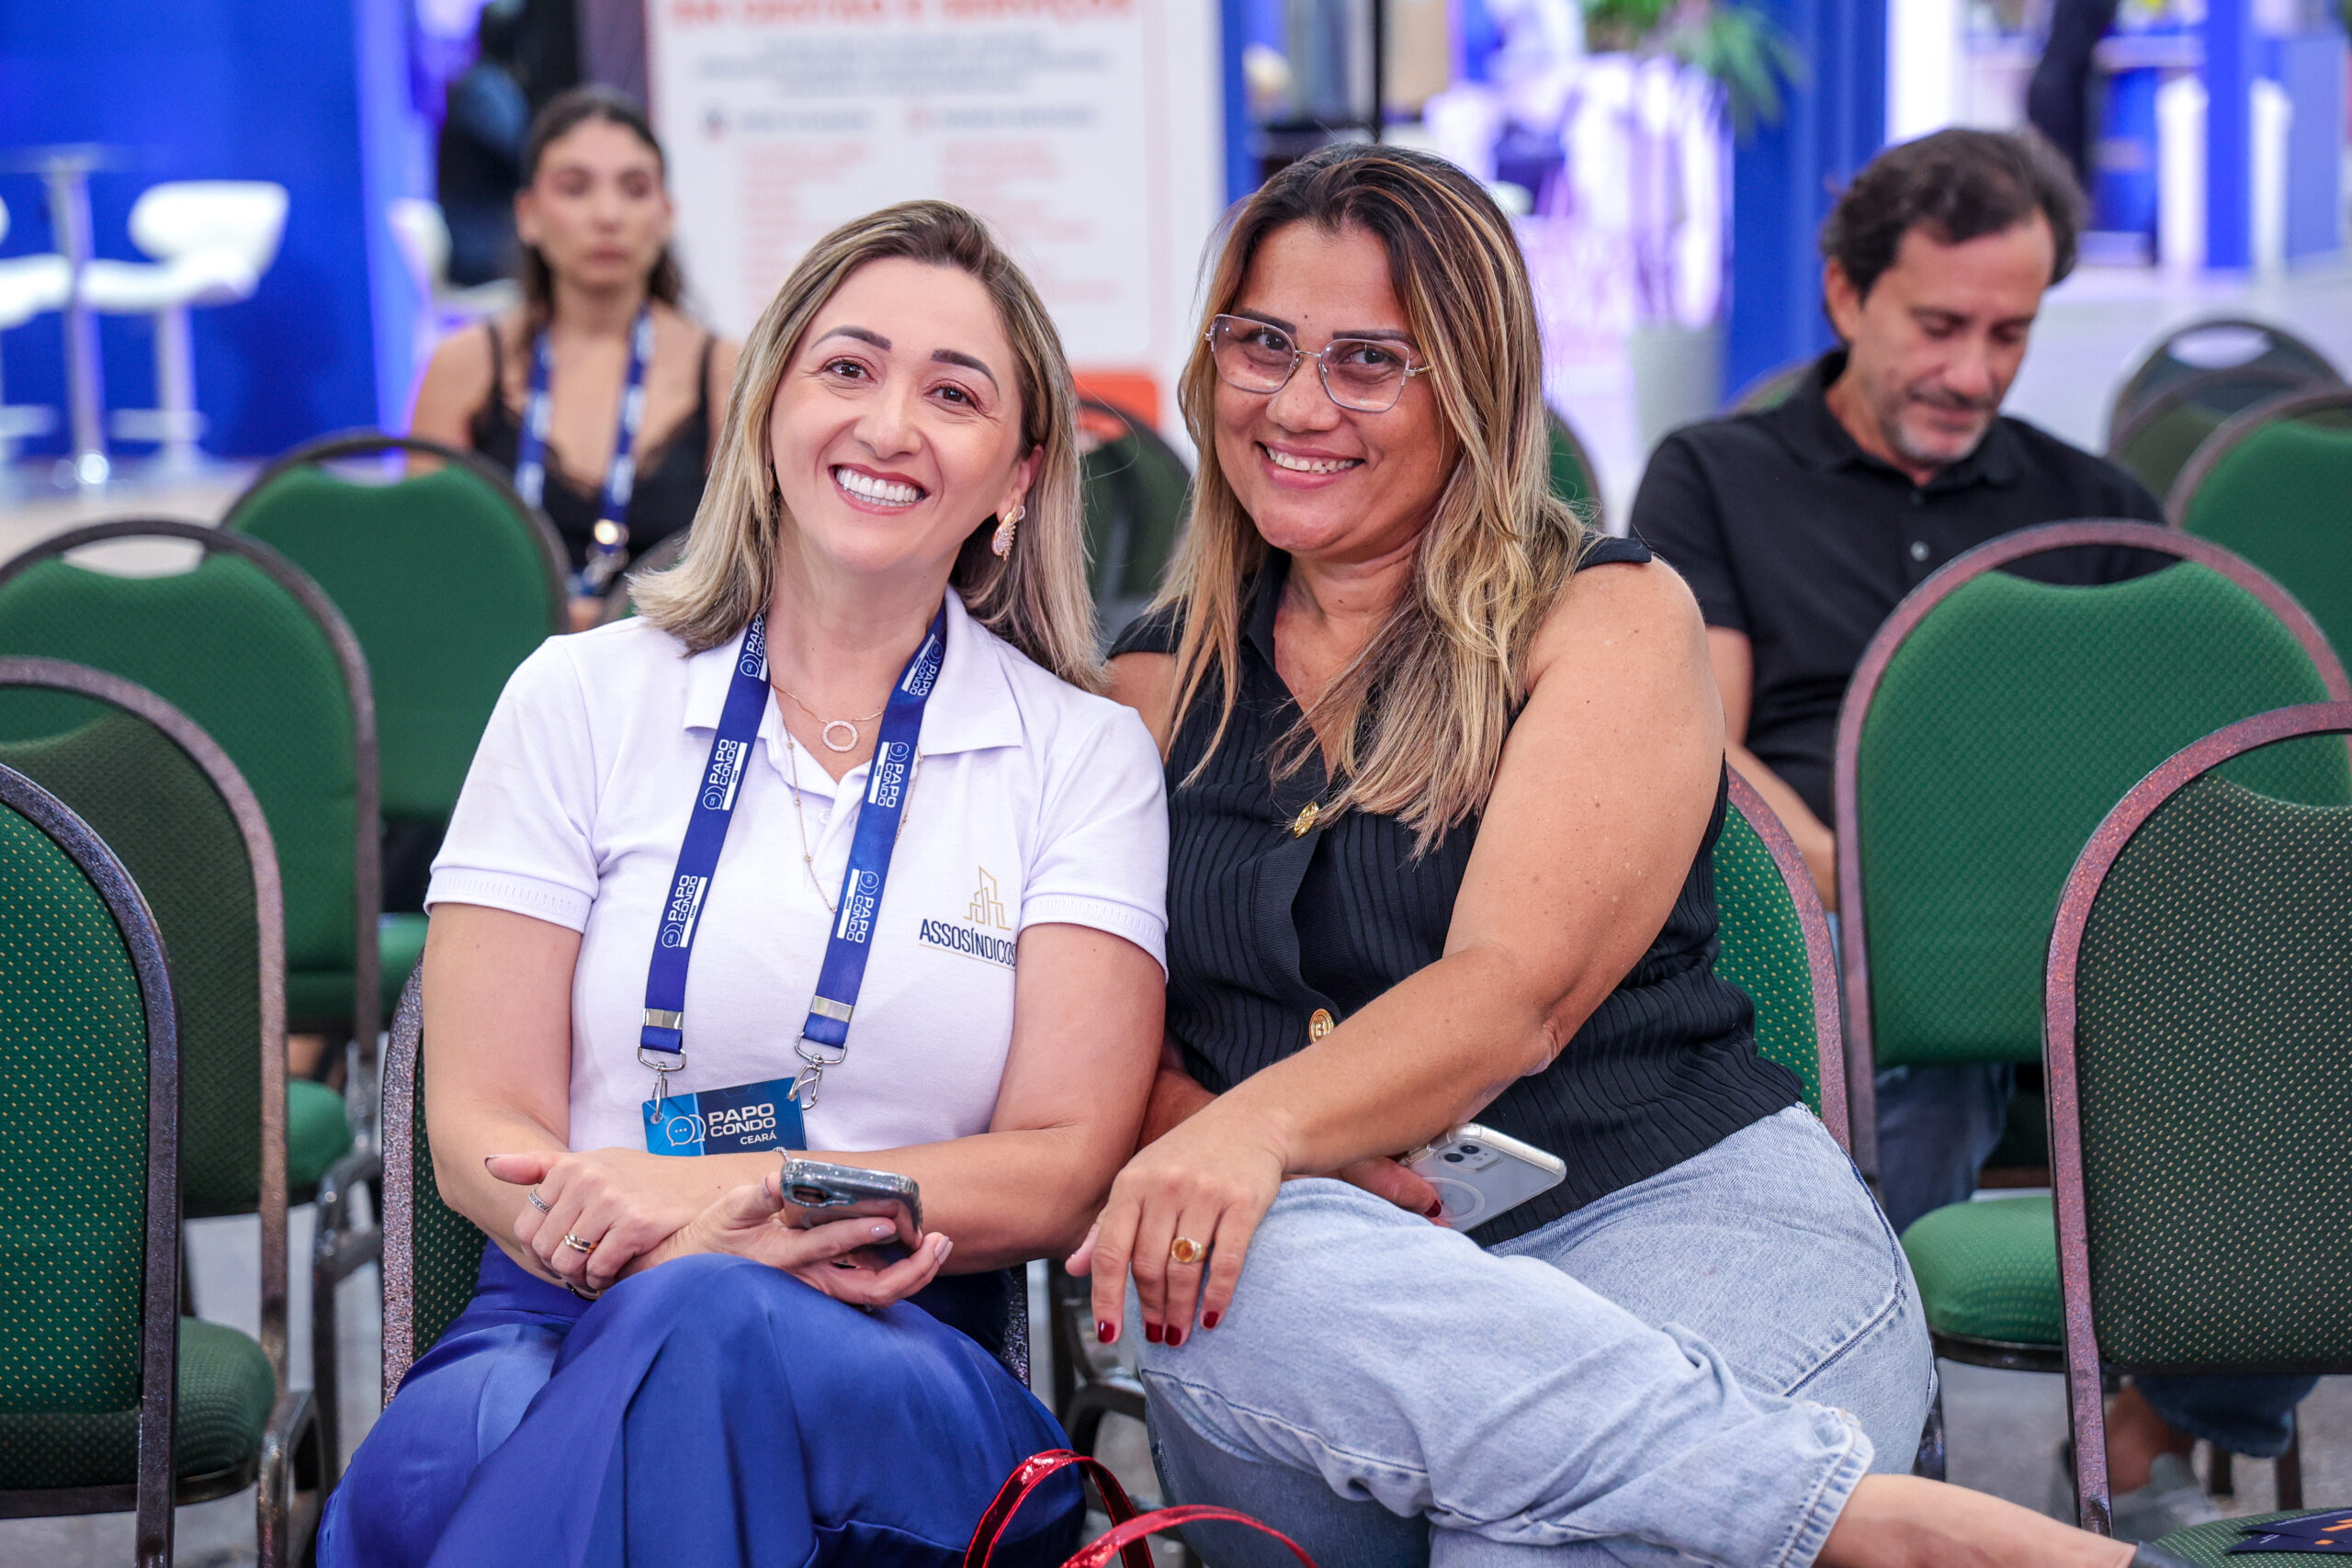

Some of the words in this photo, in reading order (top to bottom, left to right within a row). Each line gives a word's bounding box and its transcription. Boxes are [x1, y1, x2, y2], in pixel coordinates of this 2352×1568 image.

[746, 614, 763, 653] PAPO
[910, 660, 929, 695] CONDO
[918, 664, 937, 695] PAPO
[708, 739, 729, 784] PAPO
[719, 740, 738, 785] CONDO
[877, 762, 894, 807] CONDO
[886, 763, 904, 808] PAPO
[668, 874, 690, 921] PAPO
[678, 875, 698, 921] CONDO
[846, 895, 864, 942] CONDO
[854, 897, 875, 943] PAPO
[919, 919, 1016, 967] ASSOSÍNDICOS
[707, 1103, 775, 1126] PAPO
[709, 1117, 776, 1138] CONDO
[740, 1130, 777, 1145] CEARÁ
